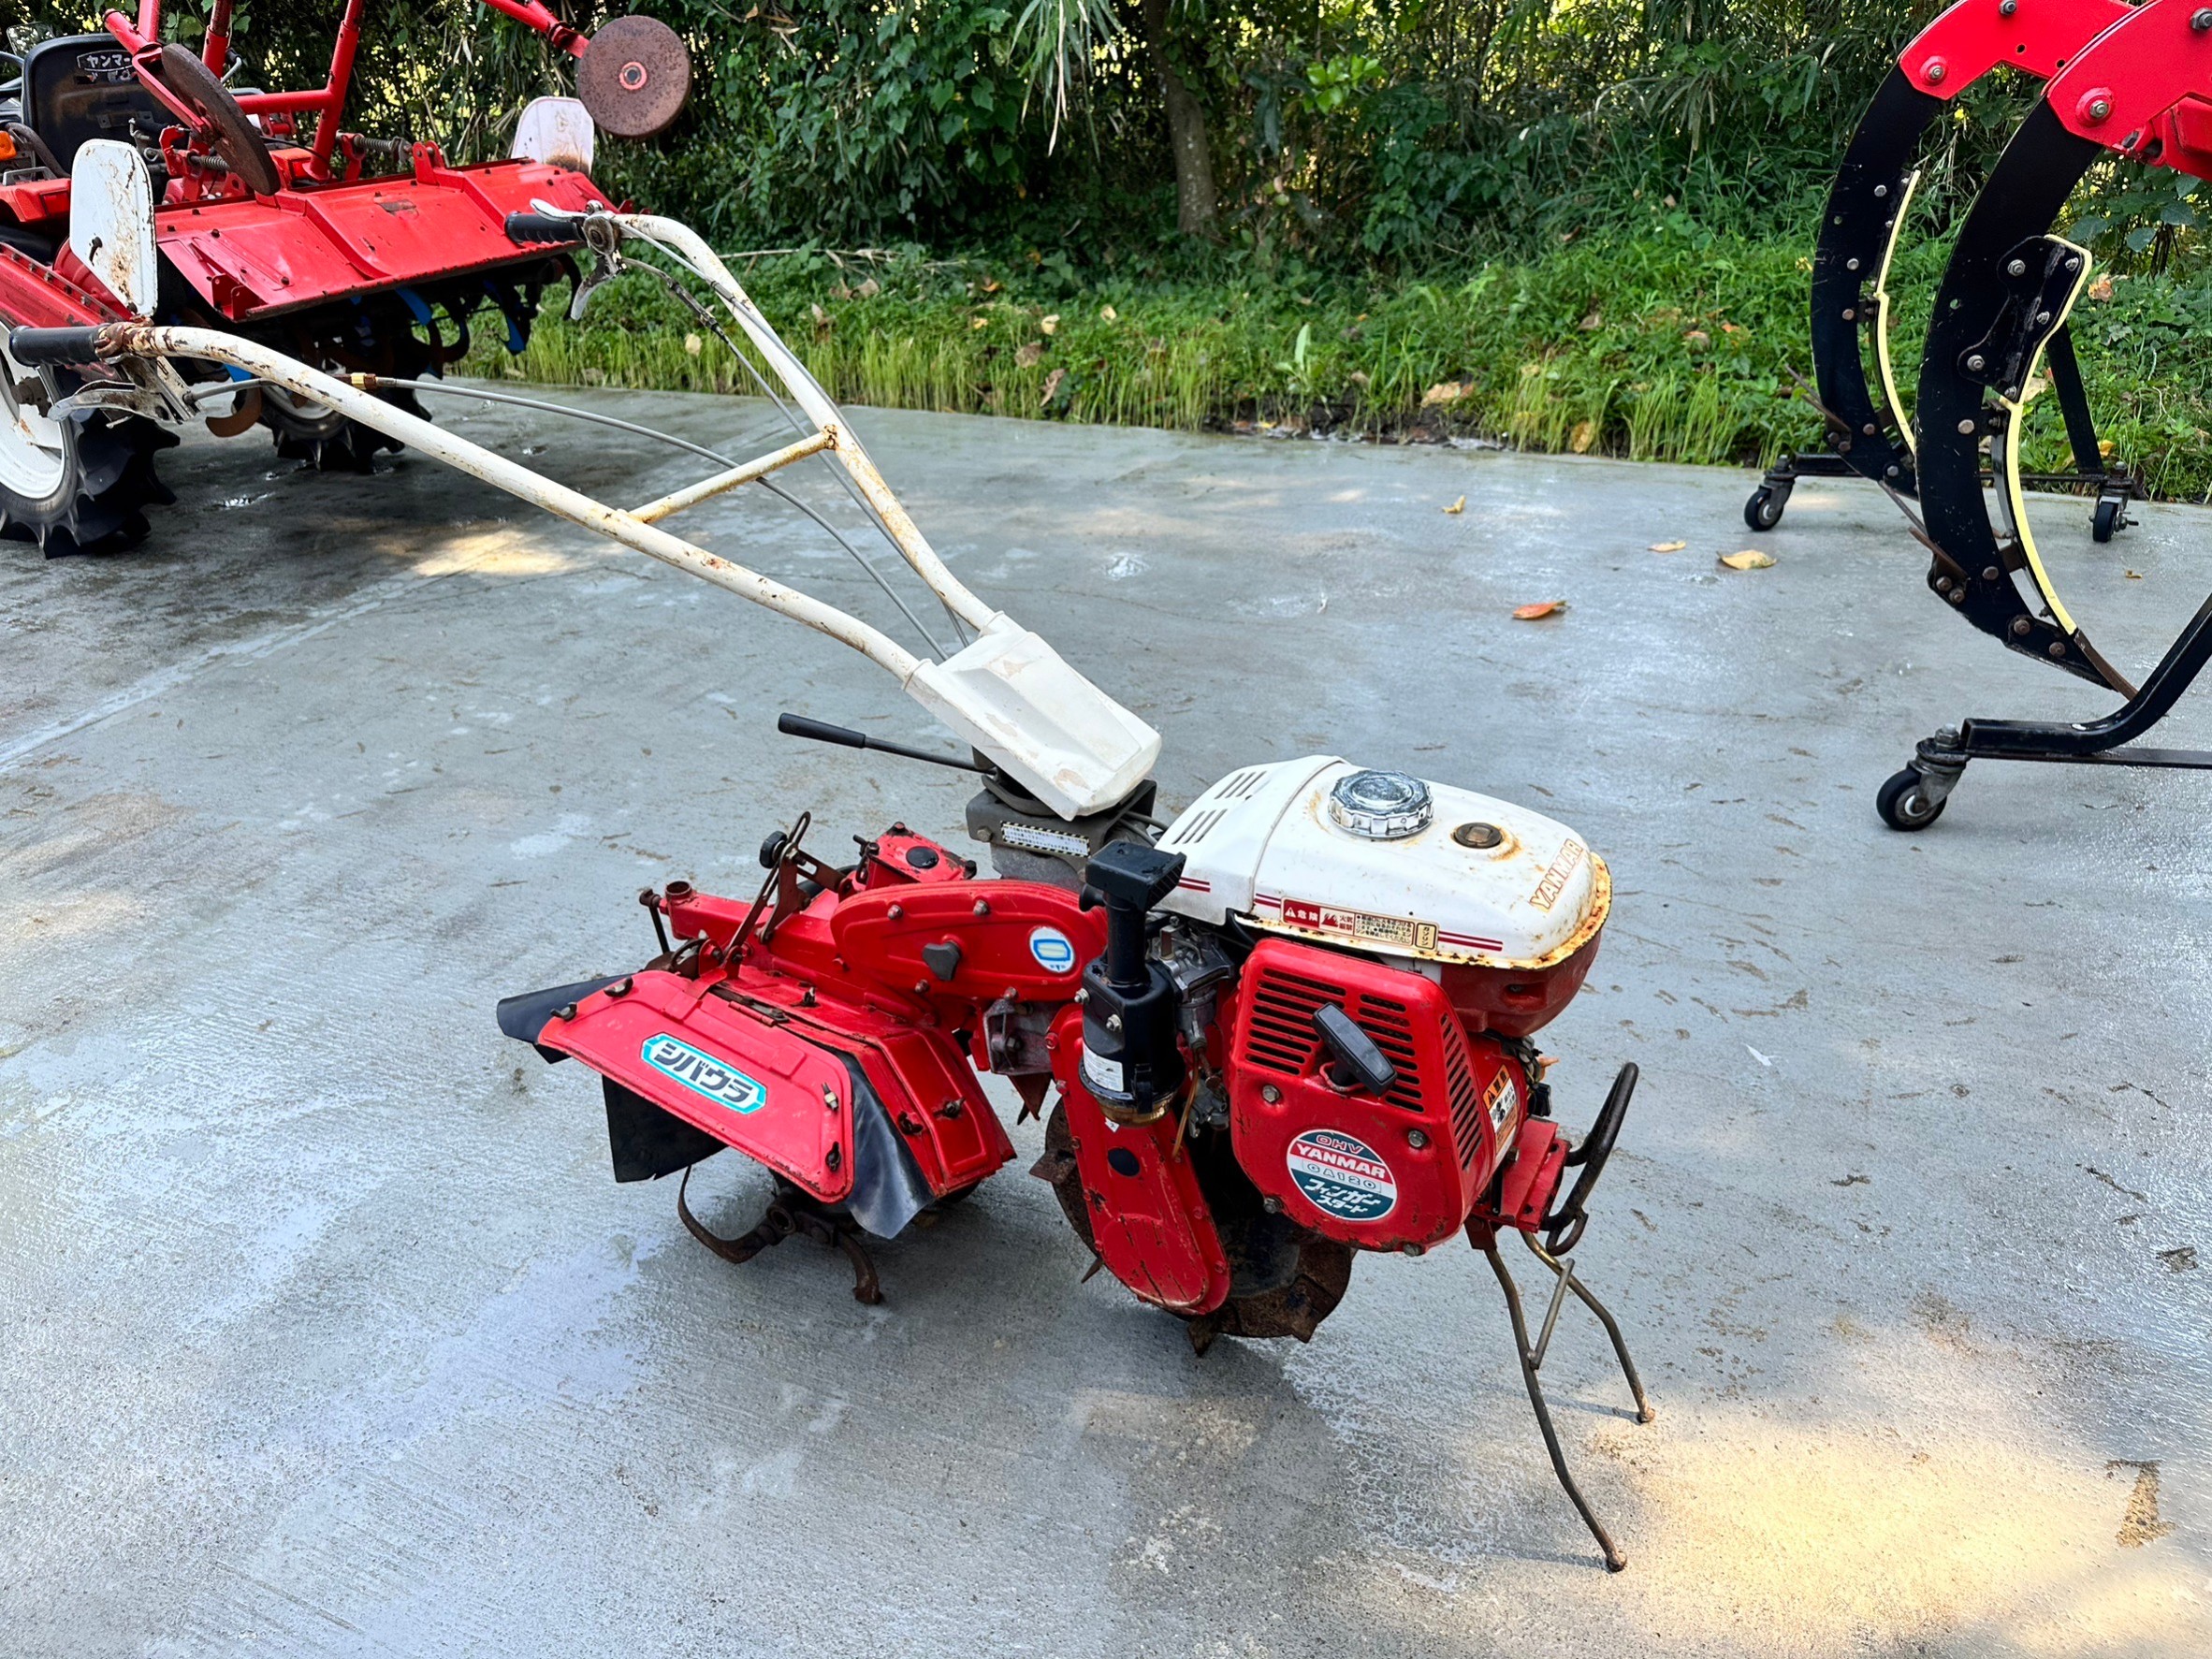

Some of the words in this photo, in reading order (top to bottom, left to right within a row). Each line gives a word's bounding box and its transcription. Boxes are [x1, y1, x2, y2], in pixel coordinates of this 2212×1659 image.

[86, 54, 131, 68] ヤンマー
[1529, 837, 1583, 911] YANMAR
[1297, 910, 1318, 922] 危険
[1421, 926, 1430, 946] ガソリン
[653, 1042, 754, 1103] シバウラ
[1316, 1134, 1364, 1155] OHV
[1296, 1142, 1386, 1179] YANMAR
[1307, 1163, 1376, 1189] GA120
[1303, 1178, 1382, 1206] フィンガー
[1316, 1194, 1369, 1213] スタート
